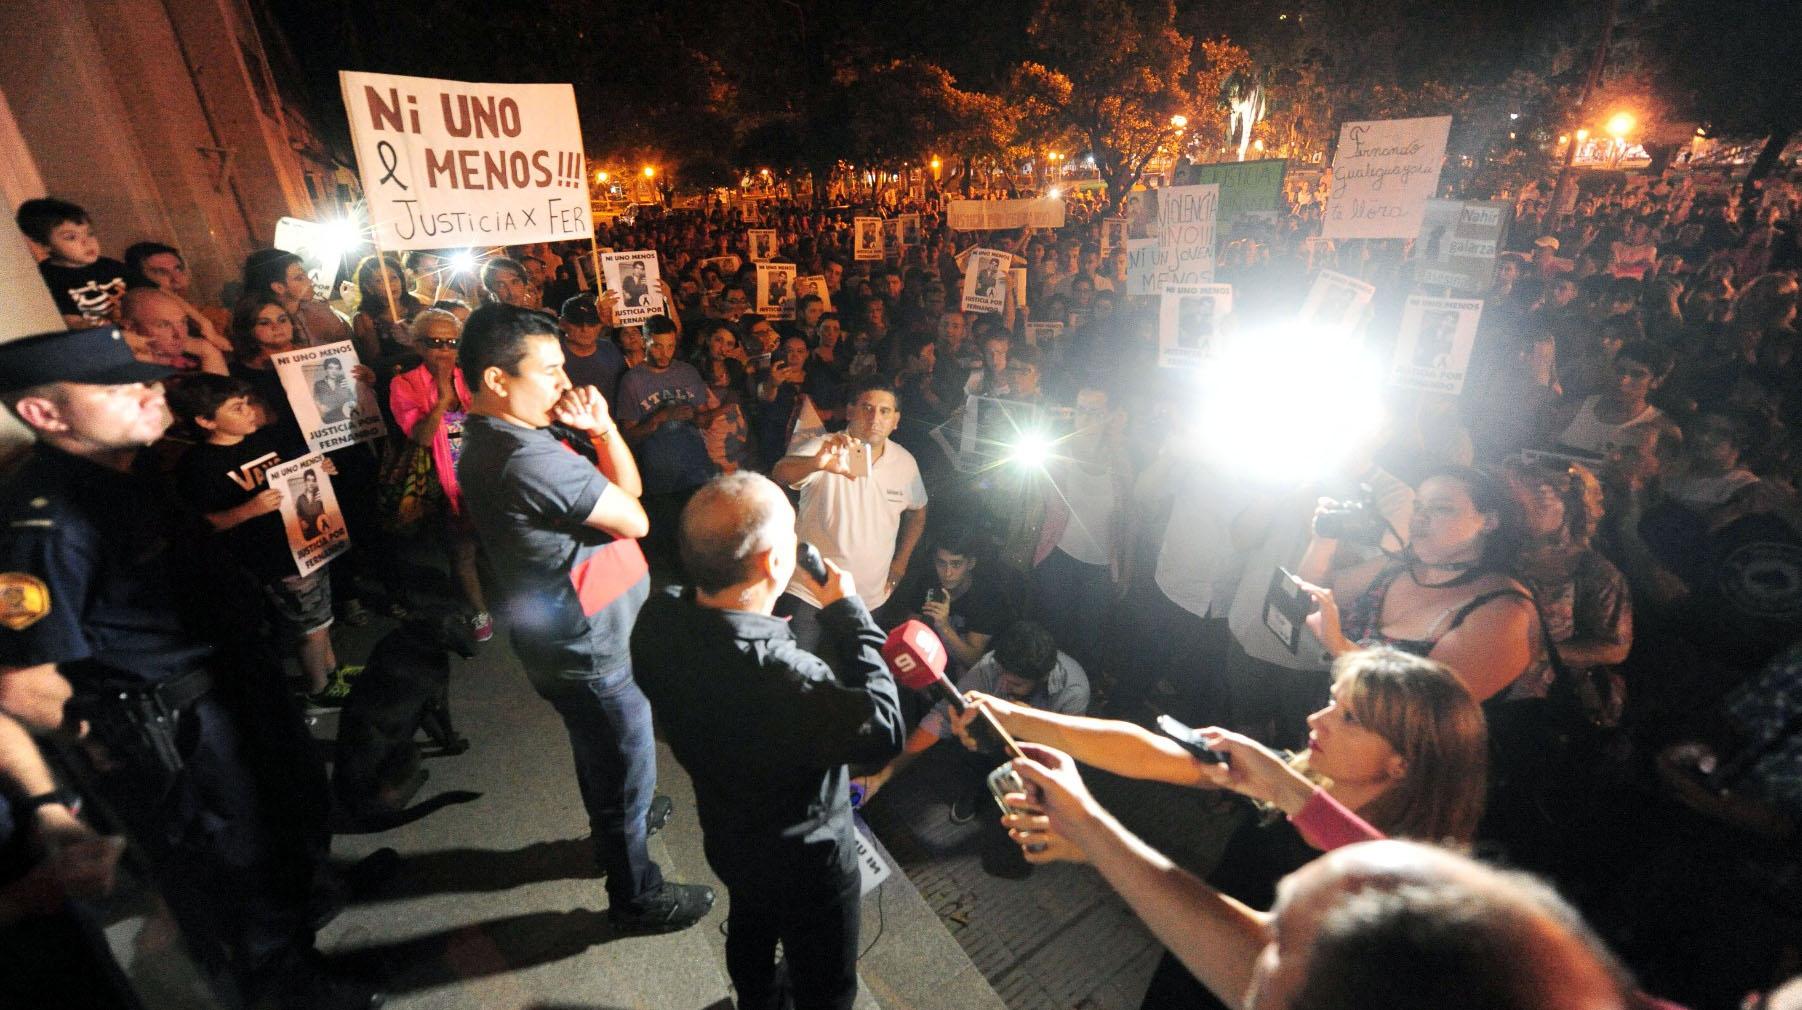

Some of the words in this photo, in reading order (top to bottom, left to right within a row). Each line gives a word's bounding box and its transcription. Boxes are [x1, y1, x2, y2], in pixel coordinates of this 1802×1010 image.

[364, 85, 421, 134] Ni
[440, 93, 522, 139] UNO
[424, 148, 581, 190] MENOS!!!
[548, 198, 586, 235] FER
[1158, 191, 1217, 227] VIOLENCIA
[1461, 208, 1498, 224] Nahir
[1151, 249, 1169, 266] UN
[1142, 271, 1212, 292] MENOS
[616, 308, 645, 316] JUSTICIA
[278, 357, 290, 365] NI
[292, 352, 317, 364] UNO
[320, 344, 352, 358] MENOS
[309, 420, 356, 440] JUSTICIA
[271, 472, 279, 480] NI
[281, 464, 298, 476] UNO
